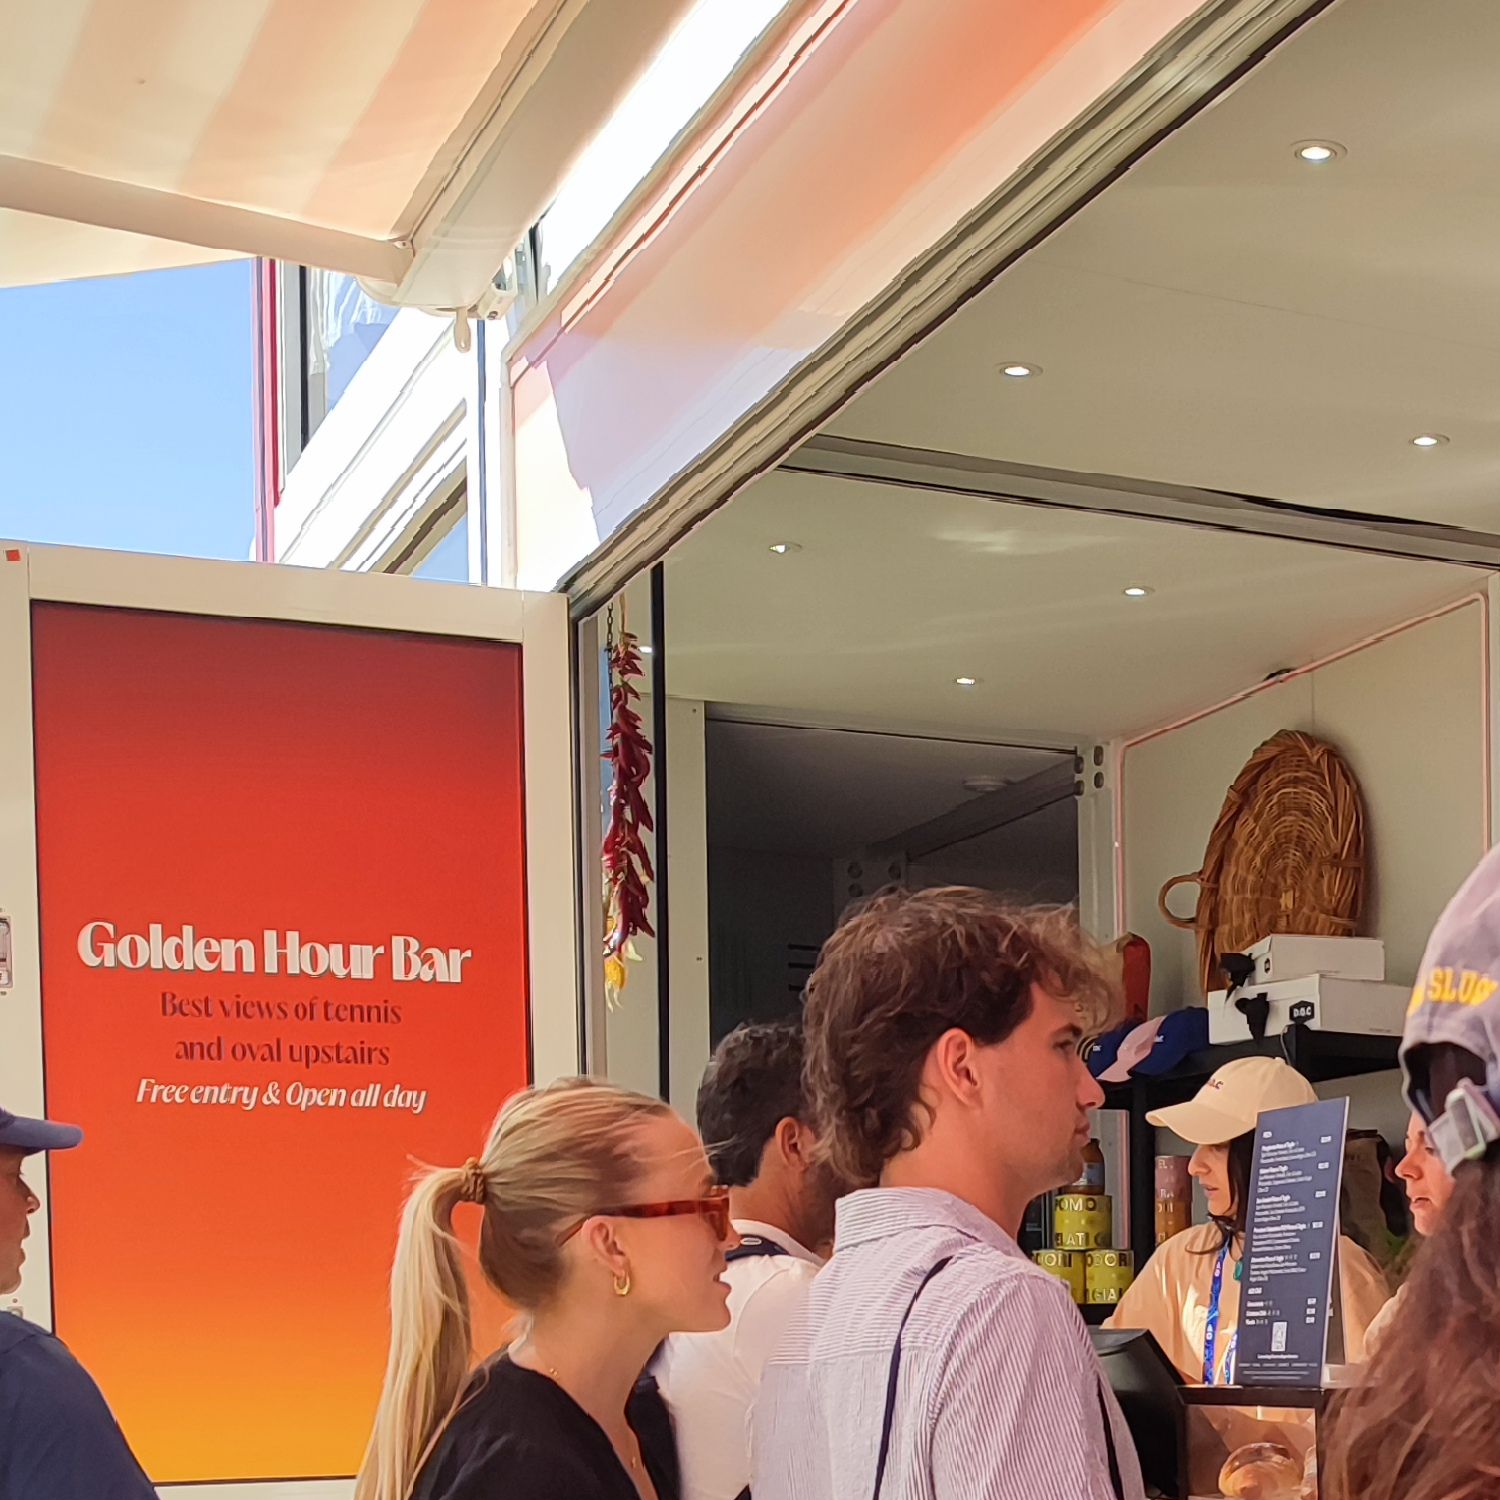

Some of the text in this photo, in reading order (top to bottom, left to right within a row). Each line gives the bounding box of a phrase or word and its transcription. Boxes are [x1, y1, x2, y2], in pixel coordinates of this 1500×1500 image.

[76, 920, 472, 983] Golden Hour Bar
[160, 991, 403, 1025] Best views of tennis
[174, 1036, 391, 1070] and oval upstairs
[136, 1077, 428, 1114] Free entry & Open all day
